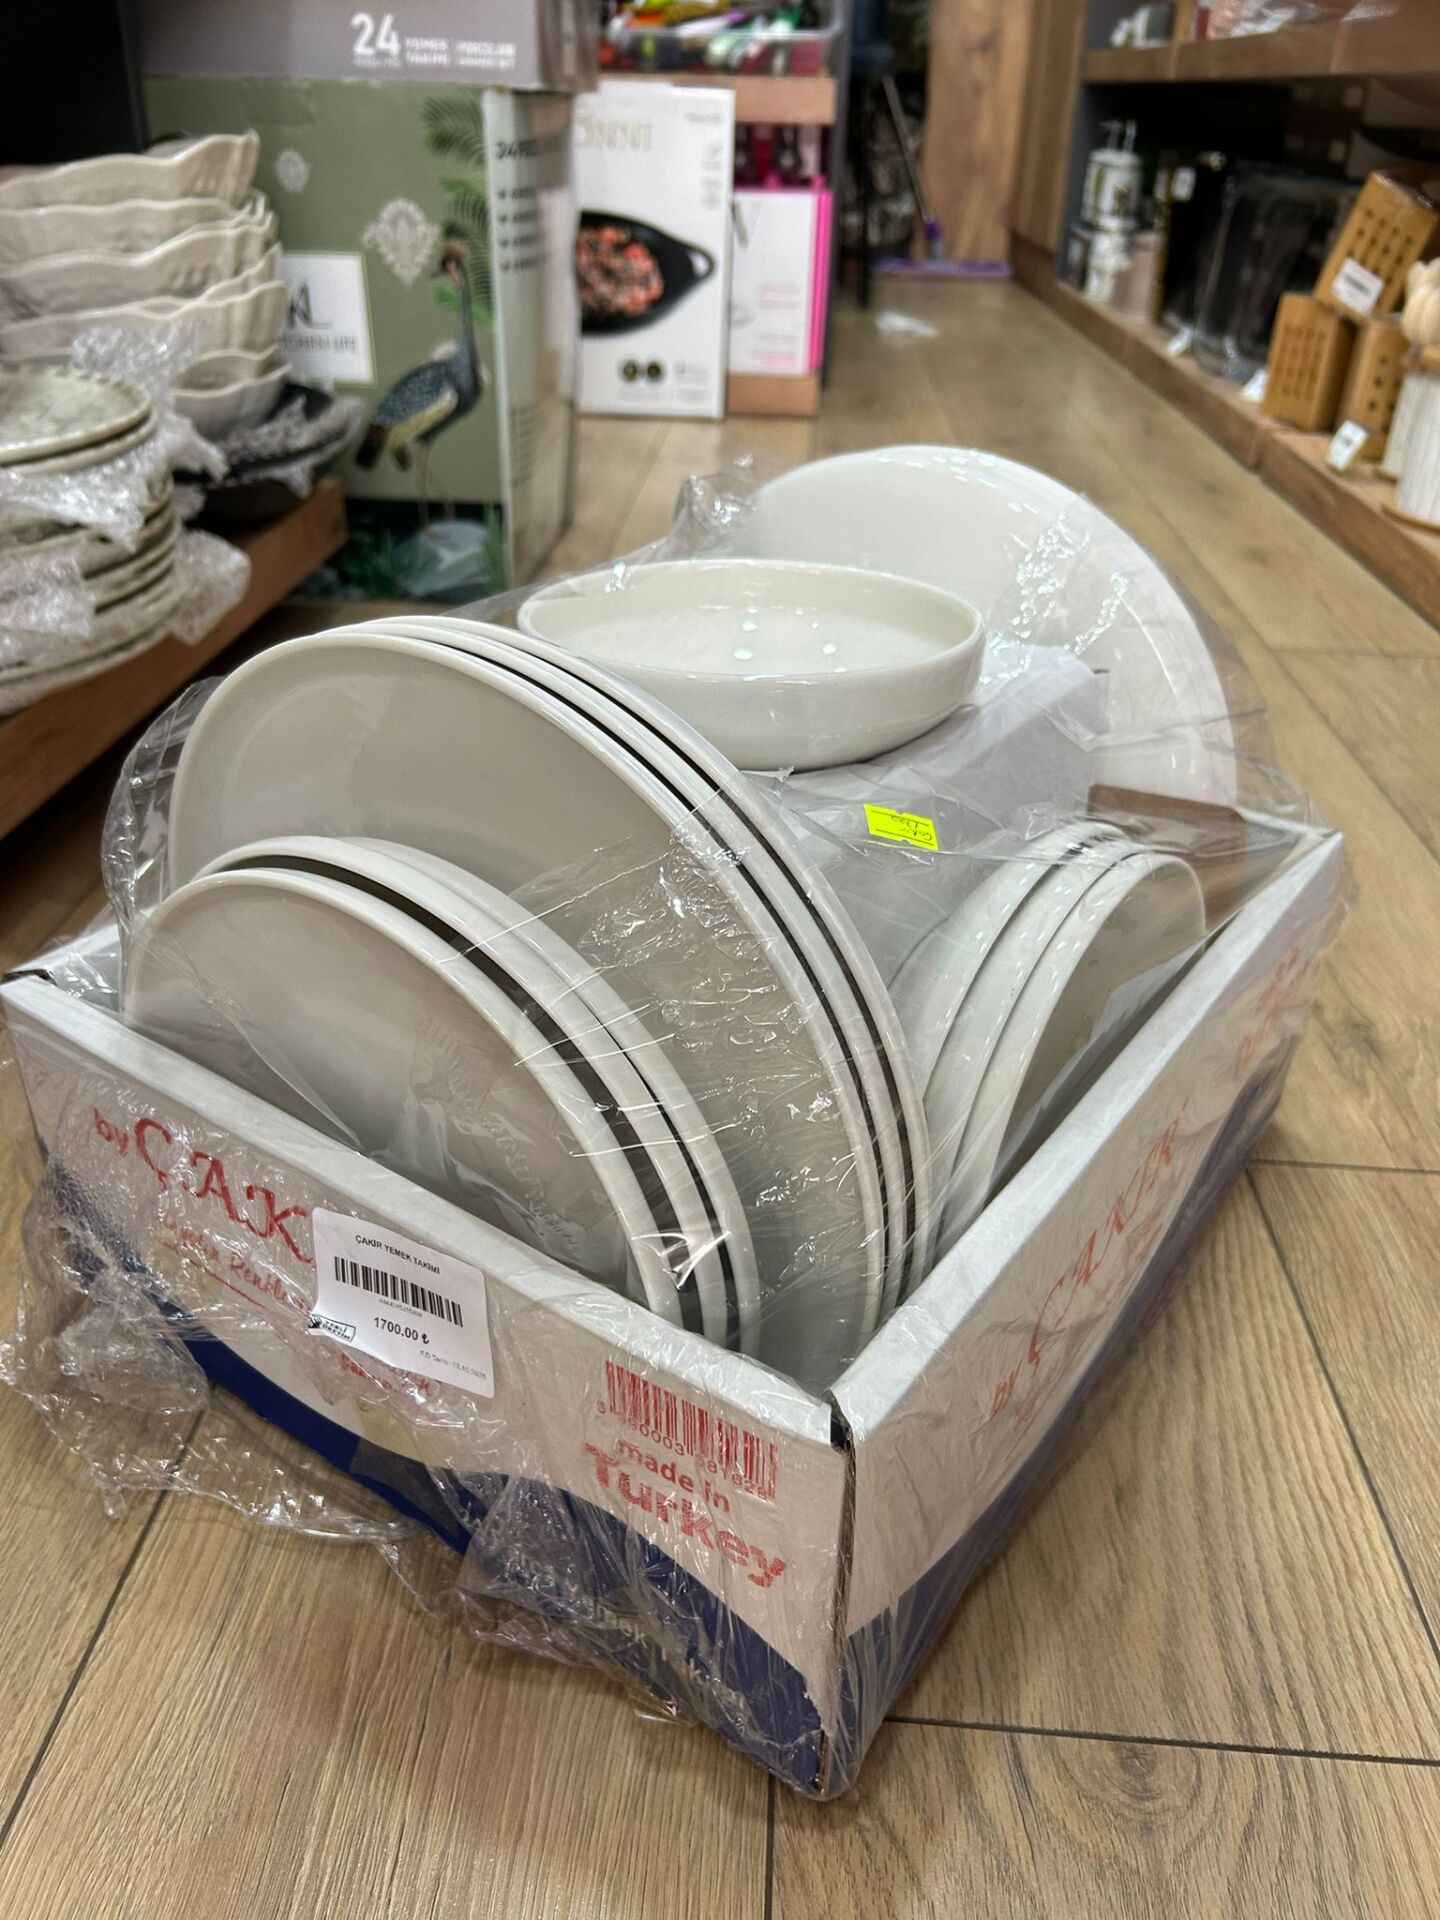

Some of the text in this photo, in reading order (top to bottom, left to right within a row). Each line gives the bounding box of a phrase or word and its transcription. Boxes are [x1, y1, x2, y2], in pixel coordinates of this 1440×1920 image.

[351, 12, 400, 55] 24
[384, 1244, 413, 1261] YEMEK
[373, 1316, 419, 1341] 1700.00
[616, 1439, 730, 1513] made in
[582, 1441, 787, 1588] Turkey
